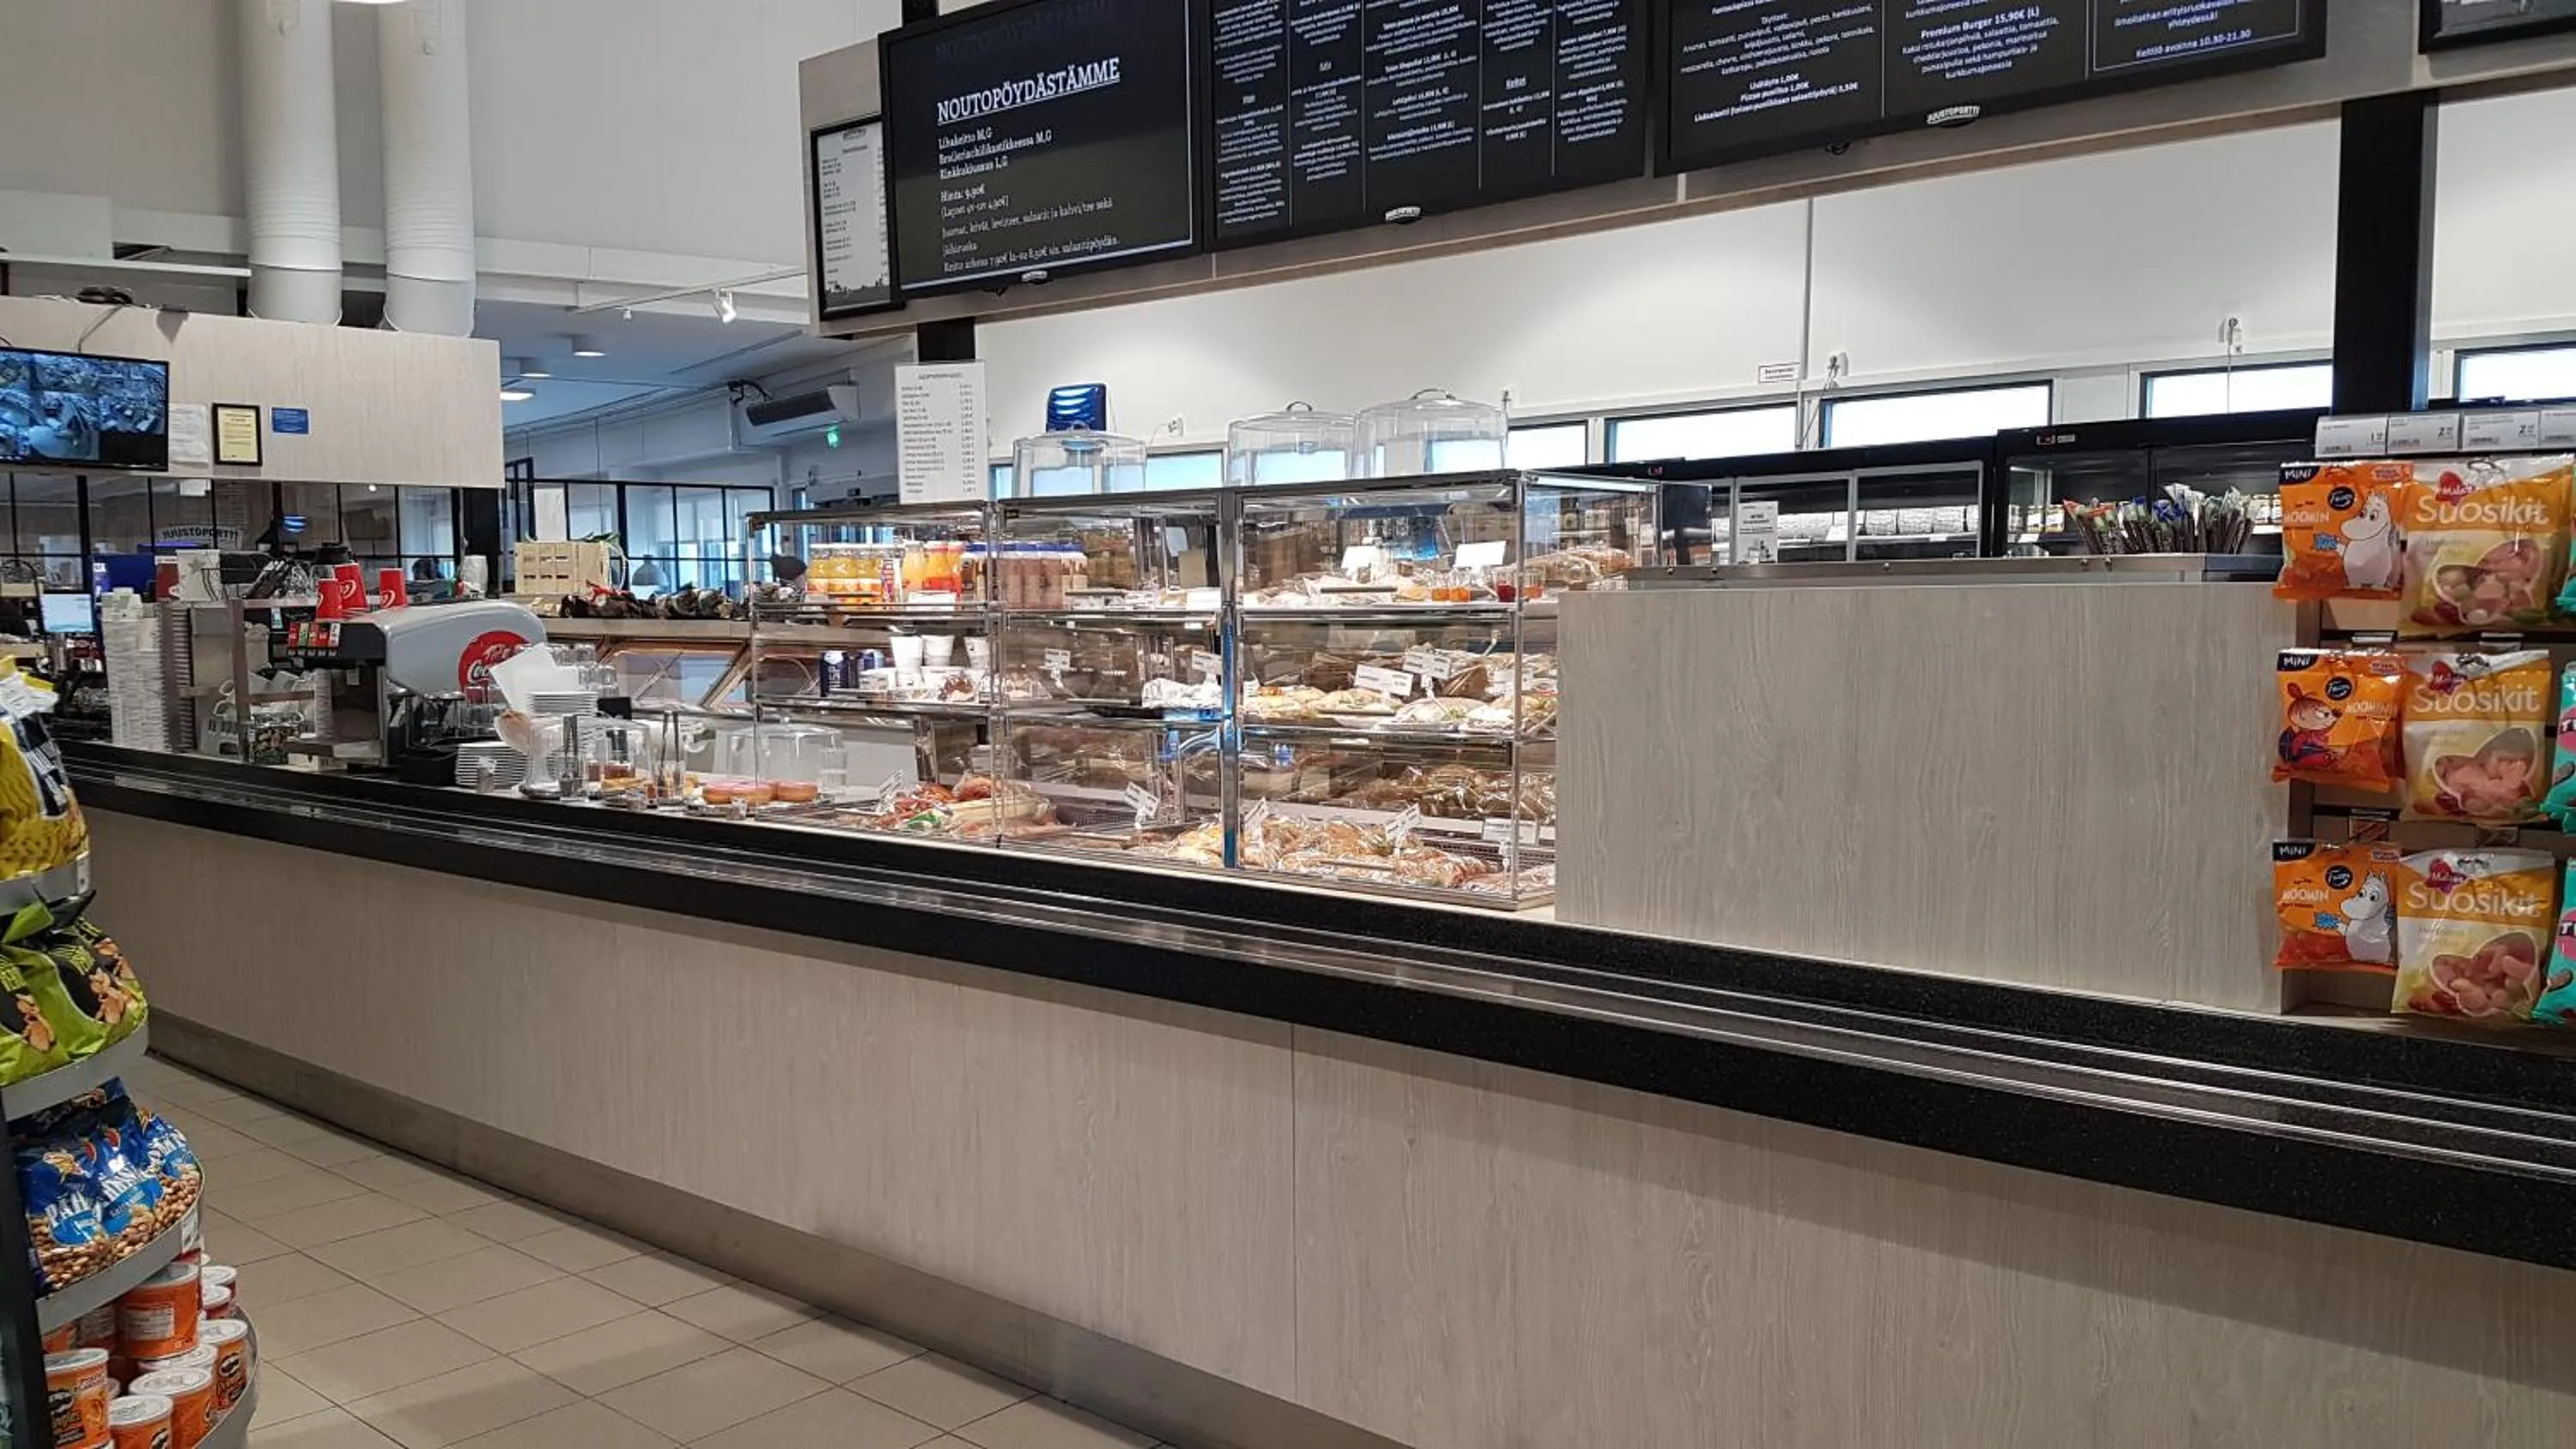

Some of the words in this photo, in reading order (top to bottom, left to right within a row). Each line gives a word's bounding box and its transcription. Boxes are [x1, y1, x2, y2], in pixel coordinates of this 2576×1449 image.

[1921, 22, 1961, 39] Premium
[1962, 17, 1993, 32] Burger
[2027, 6, 2039, 19] (L)
[2136, 45, 2164, 59] Keittiö
[2165, 39, 2197, 53] avoinna
[937, 57, 1120, 123] NOUTOPÖYDÄSTÄMME
[2285, 469, 2312, 480] MINI
[2415, 494, 2550, 525] Suosikit
[2283, 655, 2312, 666] MINI
[2411, 685, 2541, 714] Suosikit
[2278, 845, 2308, 856] MINI
[2405, 882, 2541, 919] Suosikit
